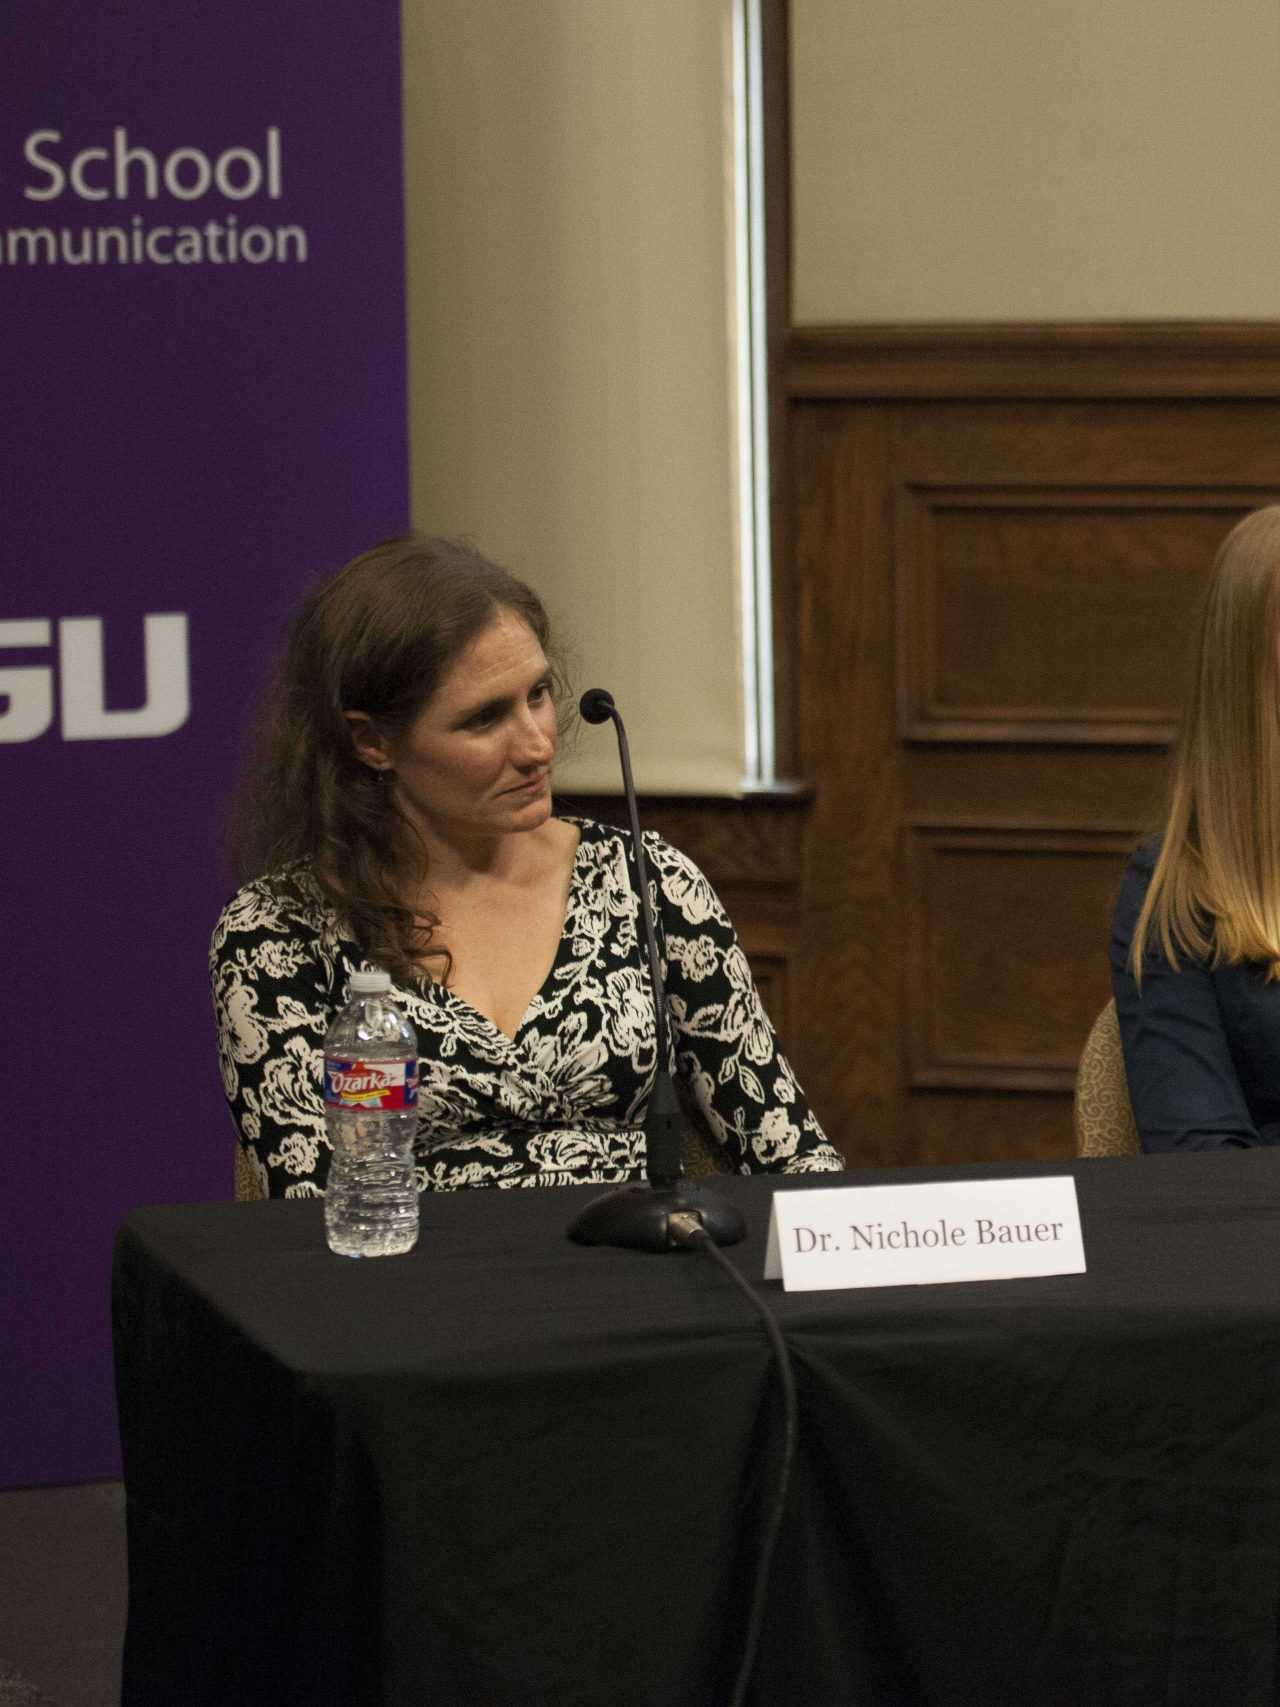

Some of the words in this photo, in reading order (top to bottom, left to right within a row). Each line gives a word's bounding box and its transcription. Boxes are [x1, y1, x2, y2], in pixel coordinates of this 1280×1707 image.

[23, 126, 281, 201] School
[0, 214, 307, 265] munication
[793, 1227, 840, 1253] Dr.
[849, 1219, 966, 1251] Nichole
[974, 1218, 1064, 1246] Bauer
